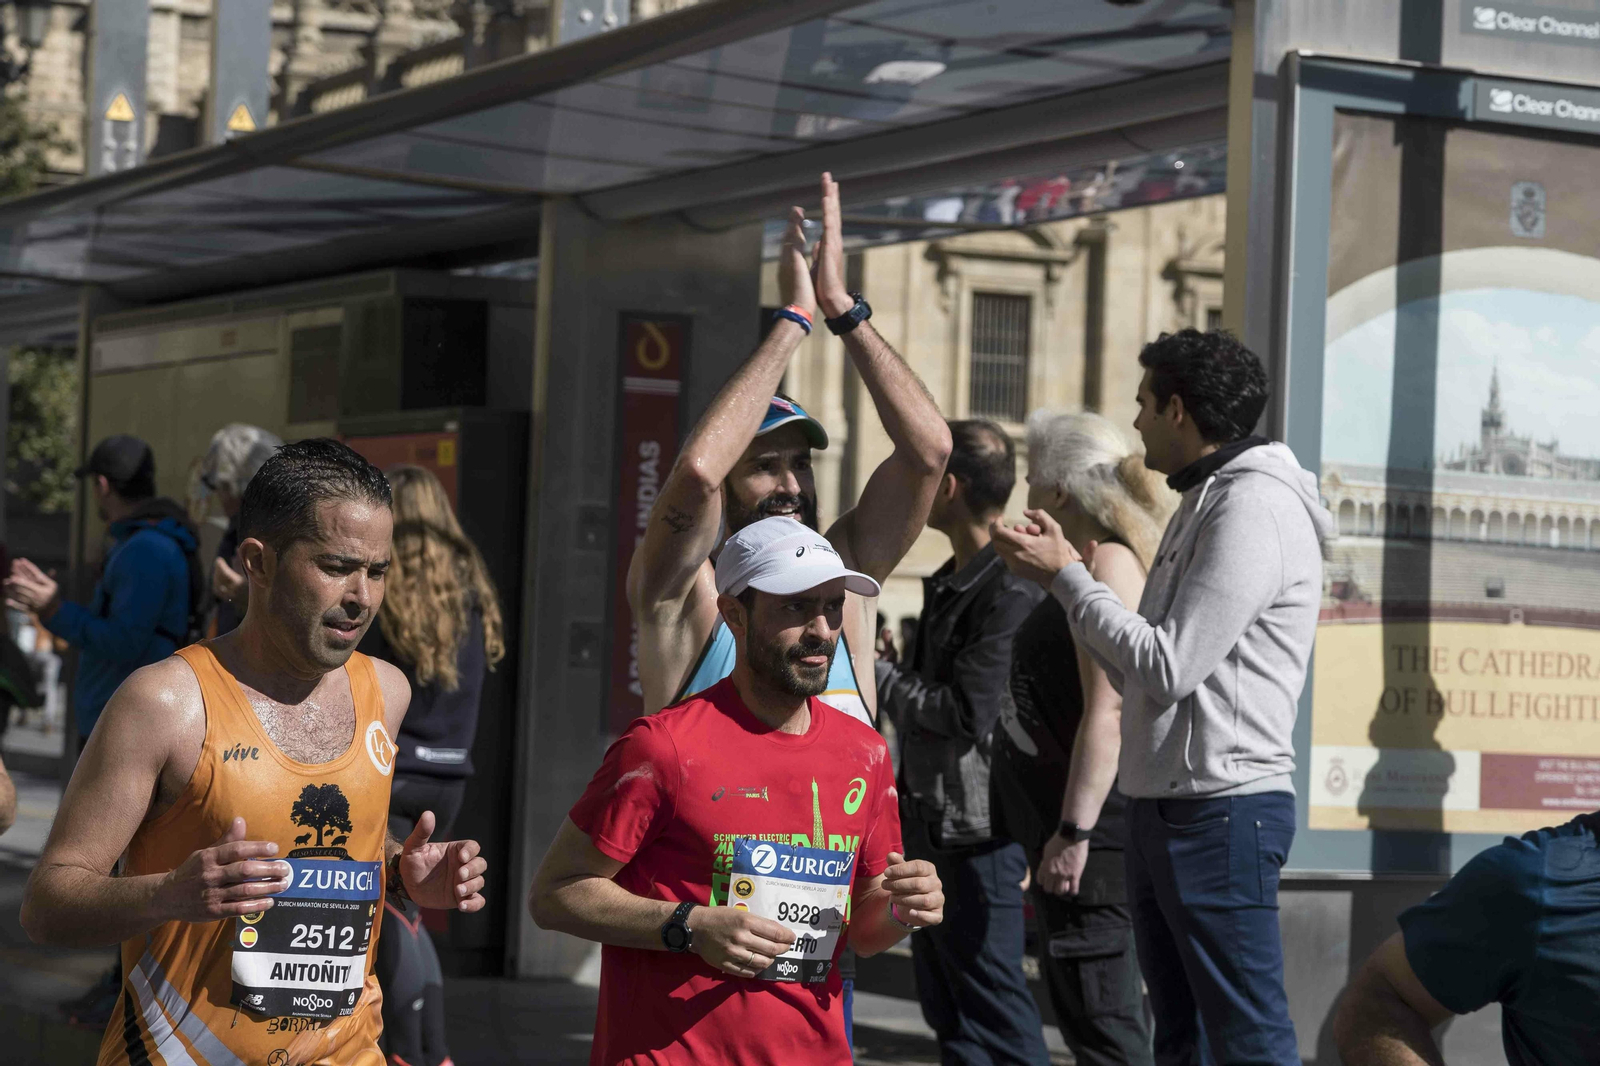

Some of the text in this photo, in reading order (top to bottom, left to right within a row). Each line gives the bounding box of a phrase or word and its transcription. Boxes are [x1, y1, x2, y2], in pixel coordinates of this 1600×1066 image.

[1497, 11, 1600, 39] Clear Channel
[1513, 93, 1554, 116] Clear
[1392, 644, 1600, 681] THE CATHEDR
[1380, 686, 1417, 716] OF
[758, 833, 790, 842] ELECTRIC
[780, 854, 844, 878] ZURICH
[298, 869, 373, 891] ZURICH
[777, 901, 820, 926] 9328
[290, 923, 355, 950] 2512
[270, 960, 352, 983] ANTOÑIT
[339, 1007, 355, 1016] ZURIC
